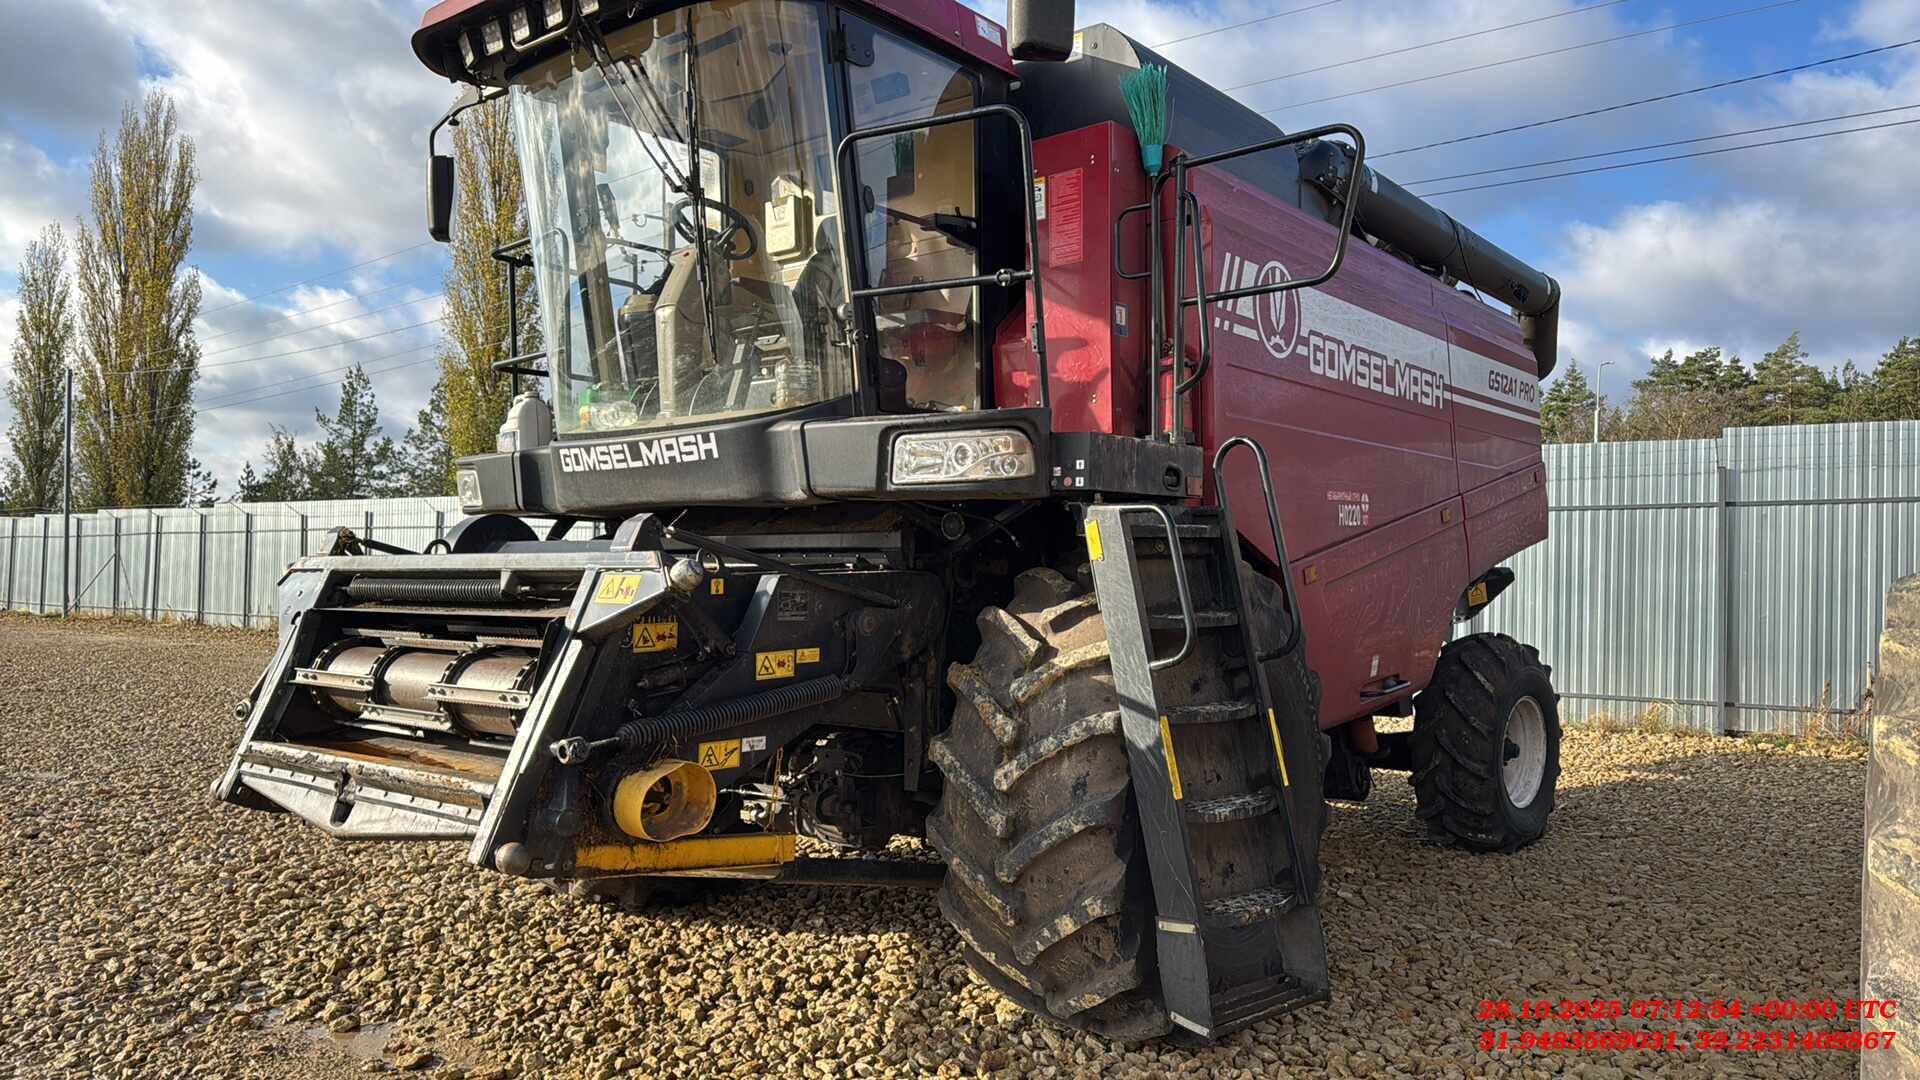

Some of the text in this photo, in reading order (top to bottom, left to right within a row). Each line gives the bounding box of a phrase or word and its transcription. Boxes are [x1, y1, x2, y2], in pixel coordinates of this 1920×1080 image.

[1309, 334, 1443, 409] GOMSELMASH
[1488, 369, 1535, 402] GS12A1 PRO
[559, 432, 719, 472] GOMSELMASH
